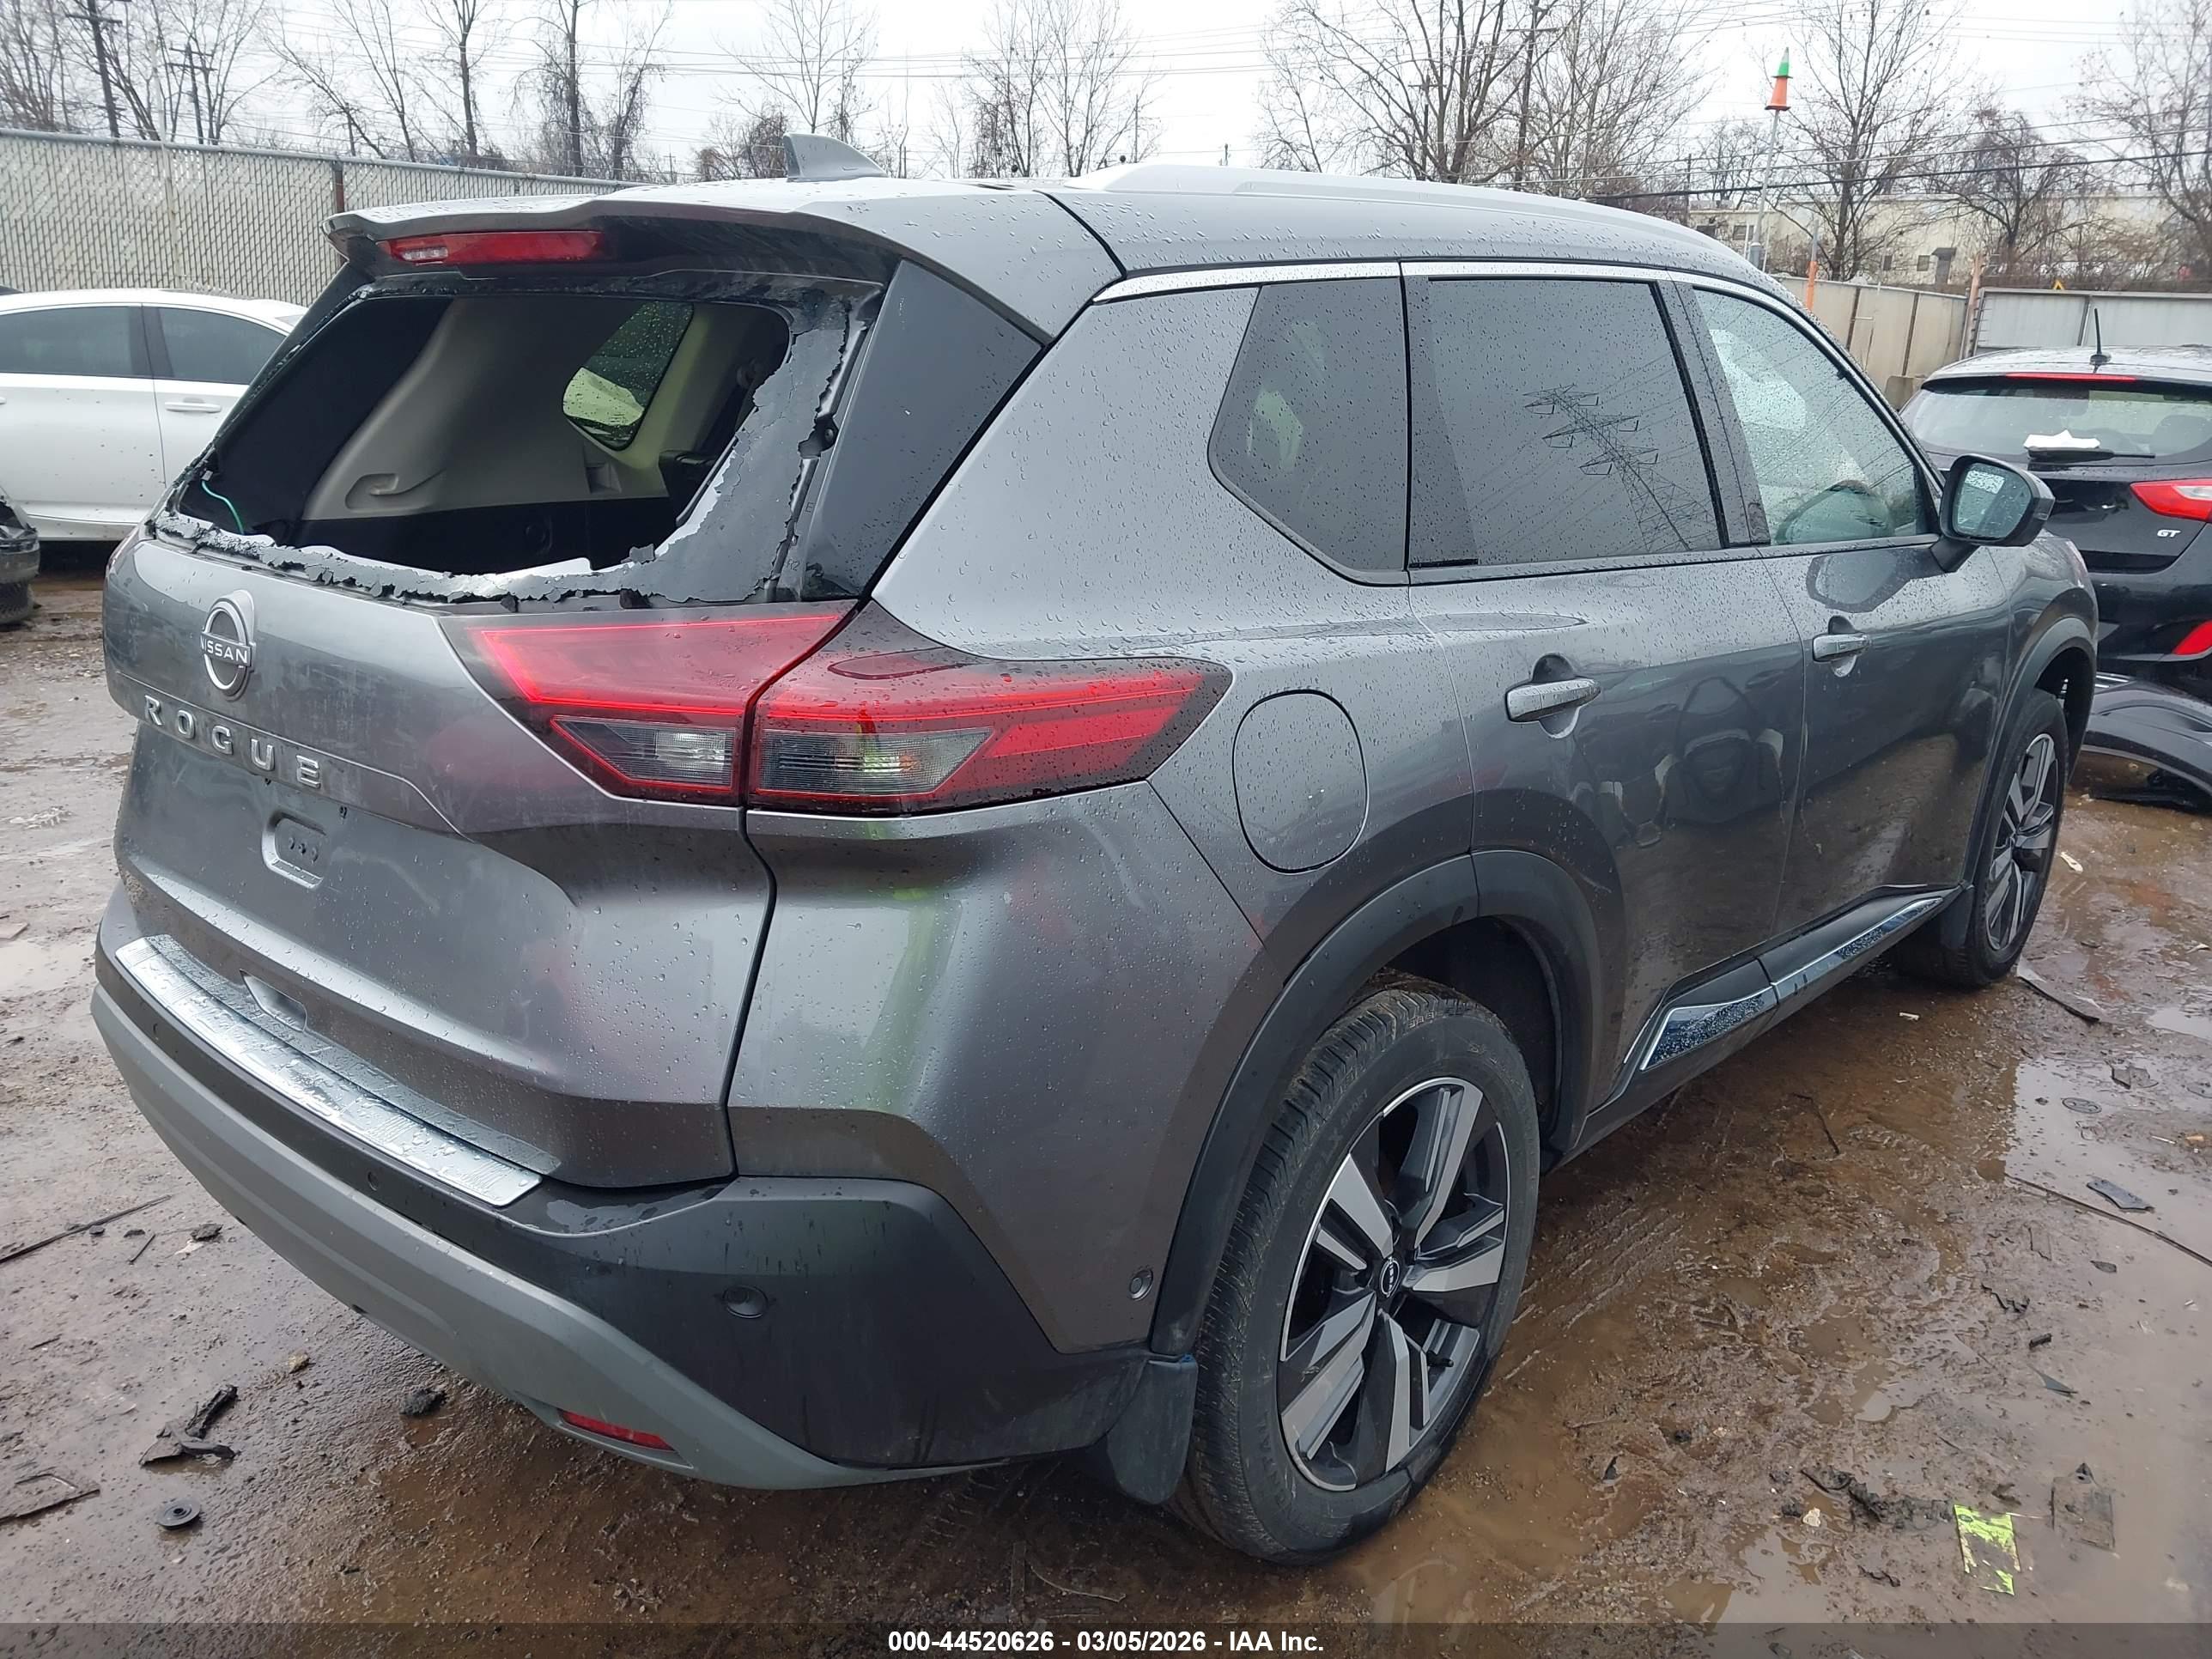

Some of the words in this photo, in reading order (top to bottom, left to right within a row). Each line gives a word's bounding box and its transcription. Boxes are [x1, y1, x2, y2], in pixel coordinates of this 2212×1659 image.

[2157, 529, 2181, 538] GT
[200, 635, 248, 664] NISSAN
[144, 695, 320, 788] ROGUE
